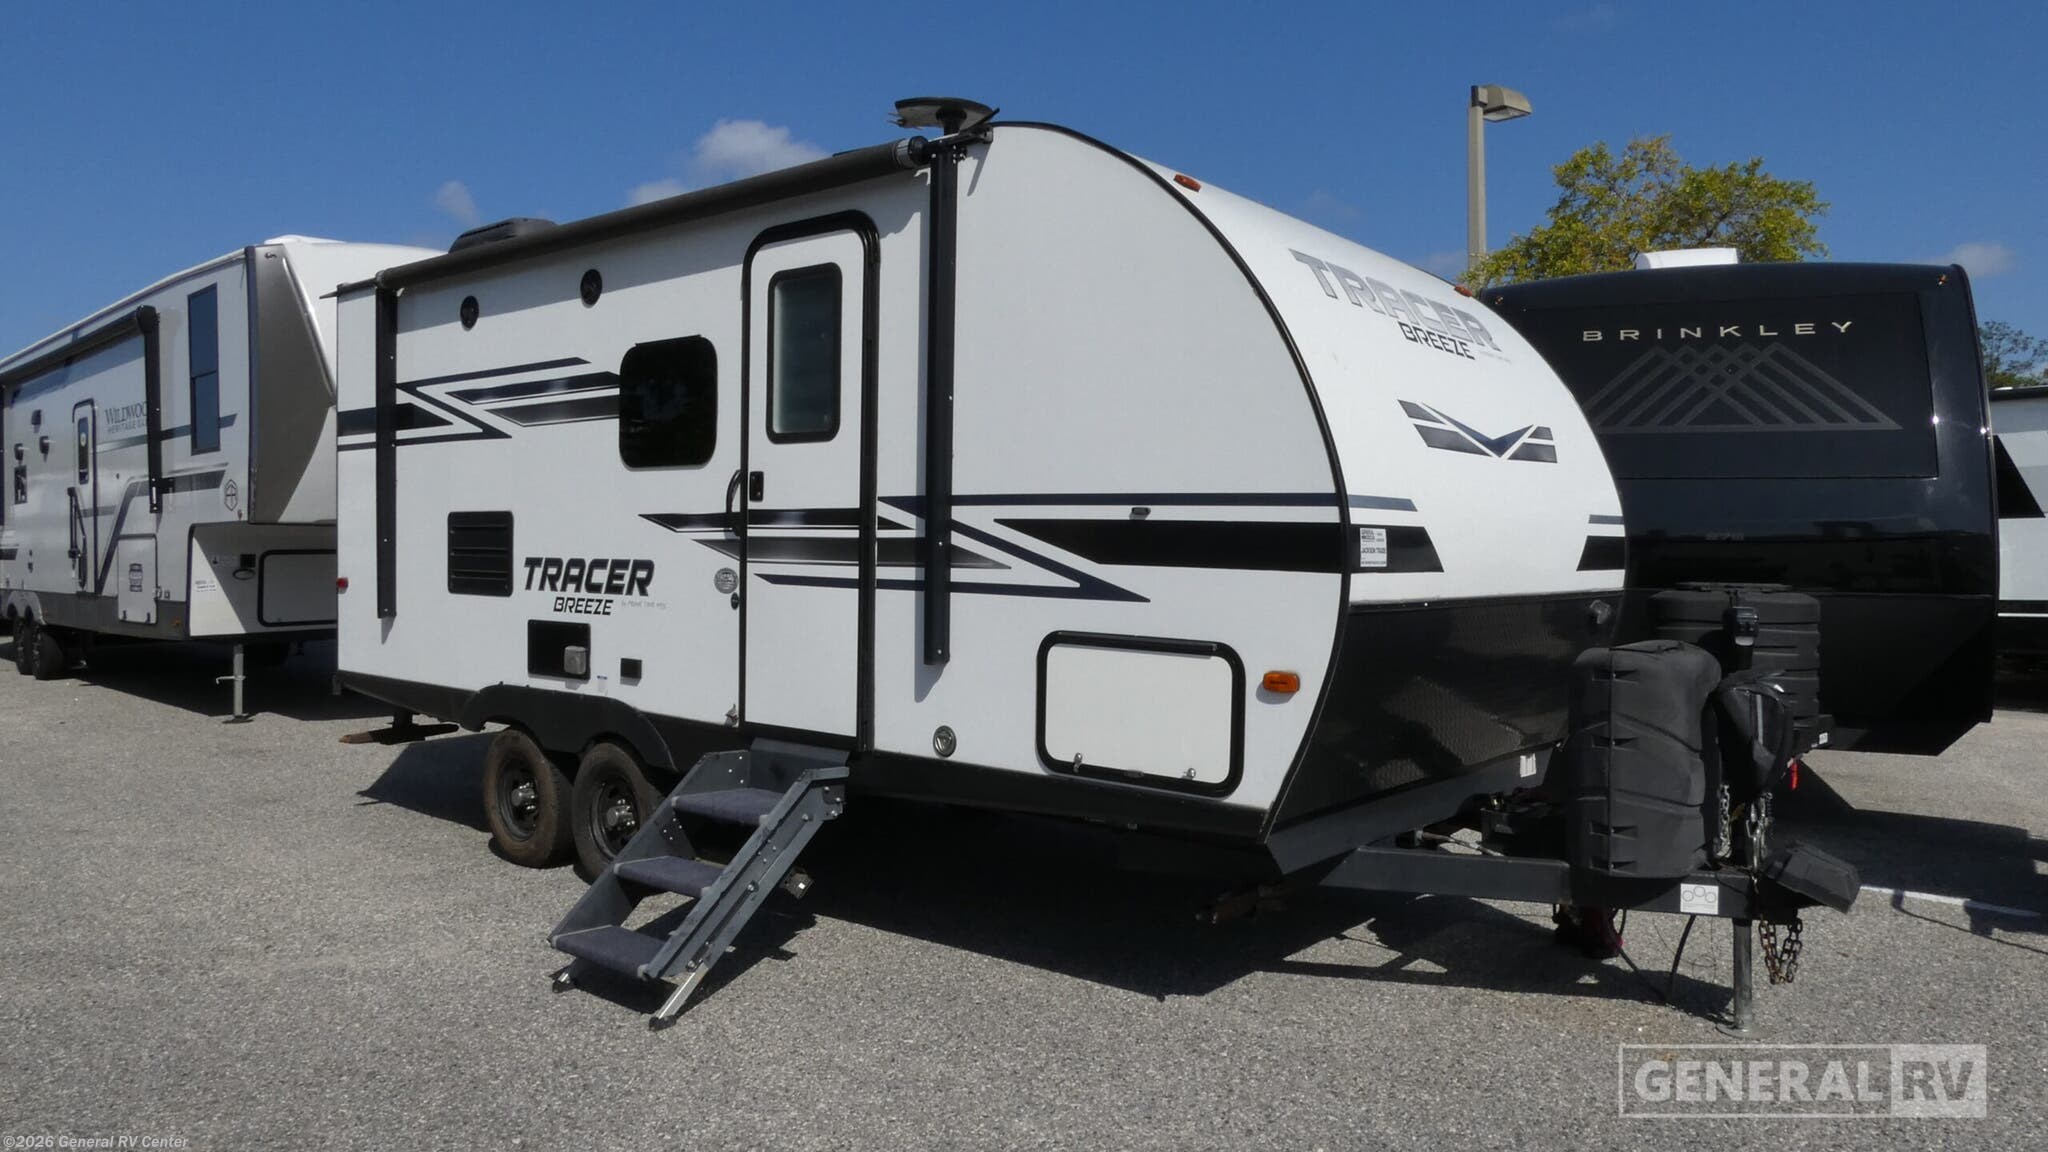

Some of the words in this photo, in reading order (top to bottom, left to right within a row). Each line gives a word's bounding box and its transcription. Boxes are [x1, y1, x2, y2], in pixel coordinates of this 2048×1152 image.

[1288, 248, 1502, 352] TRACER
[1398, 321, 1475, 360] BREEZE
[1582, 321, 1853, 342] BRINKLEY
[524, 556, 655, 597] TRACER
[553, 596, 614, 616] BREEZE
